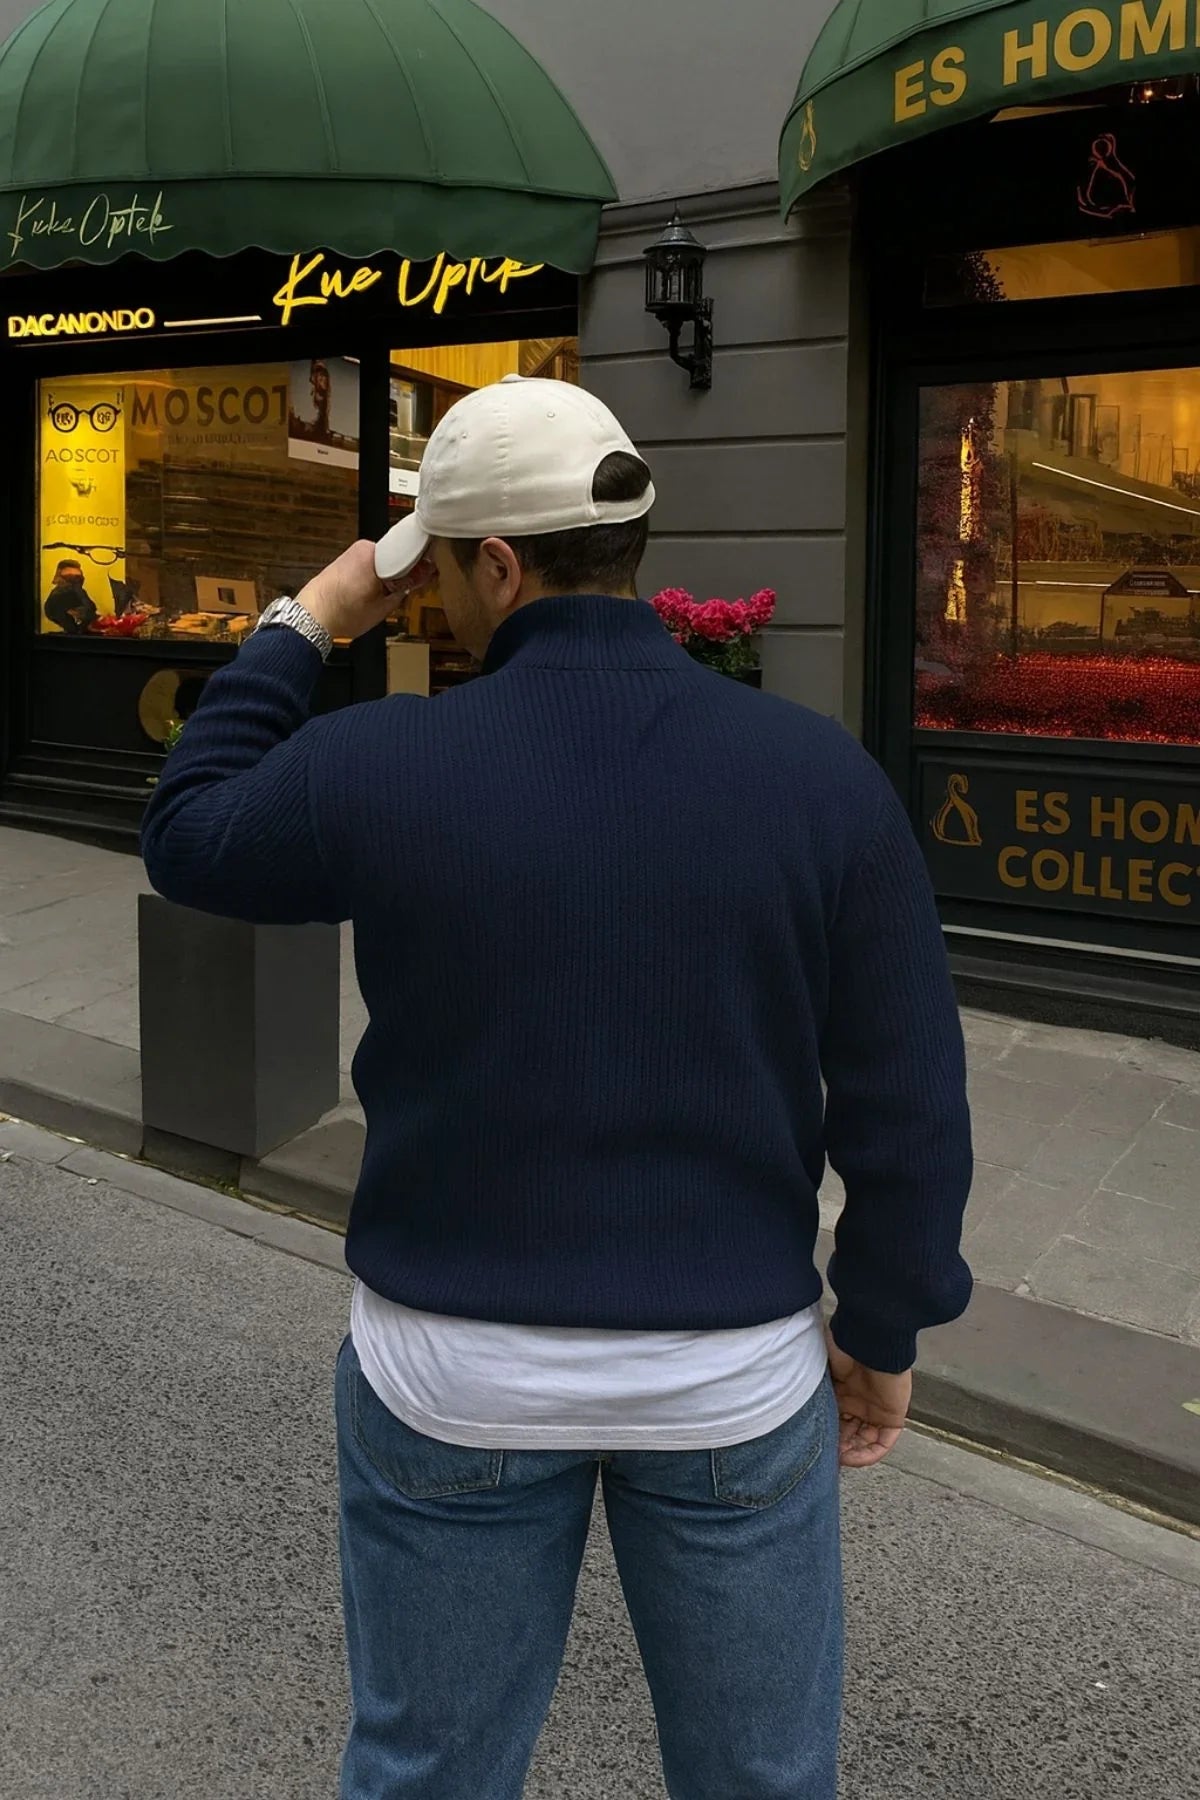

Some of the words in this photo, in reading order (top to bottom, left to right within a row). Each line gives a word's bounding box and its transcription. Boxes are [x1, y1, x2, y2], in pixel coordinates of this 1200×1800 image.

[893, 45, 968, 123] ES
[1003, 0, 1200, 87] HOM
[131, 384, 287, 426] MOSCOT
[1015, 790, 1071, 835] ES
[997, 846, 1200, 907] COLLEC
